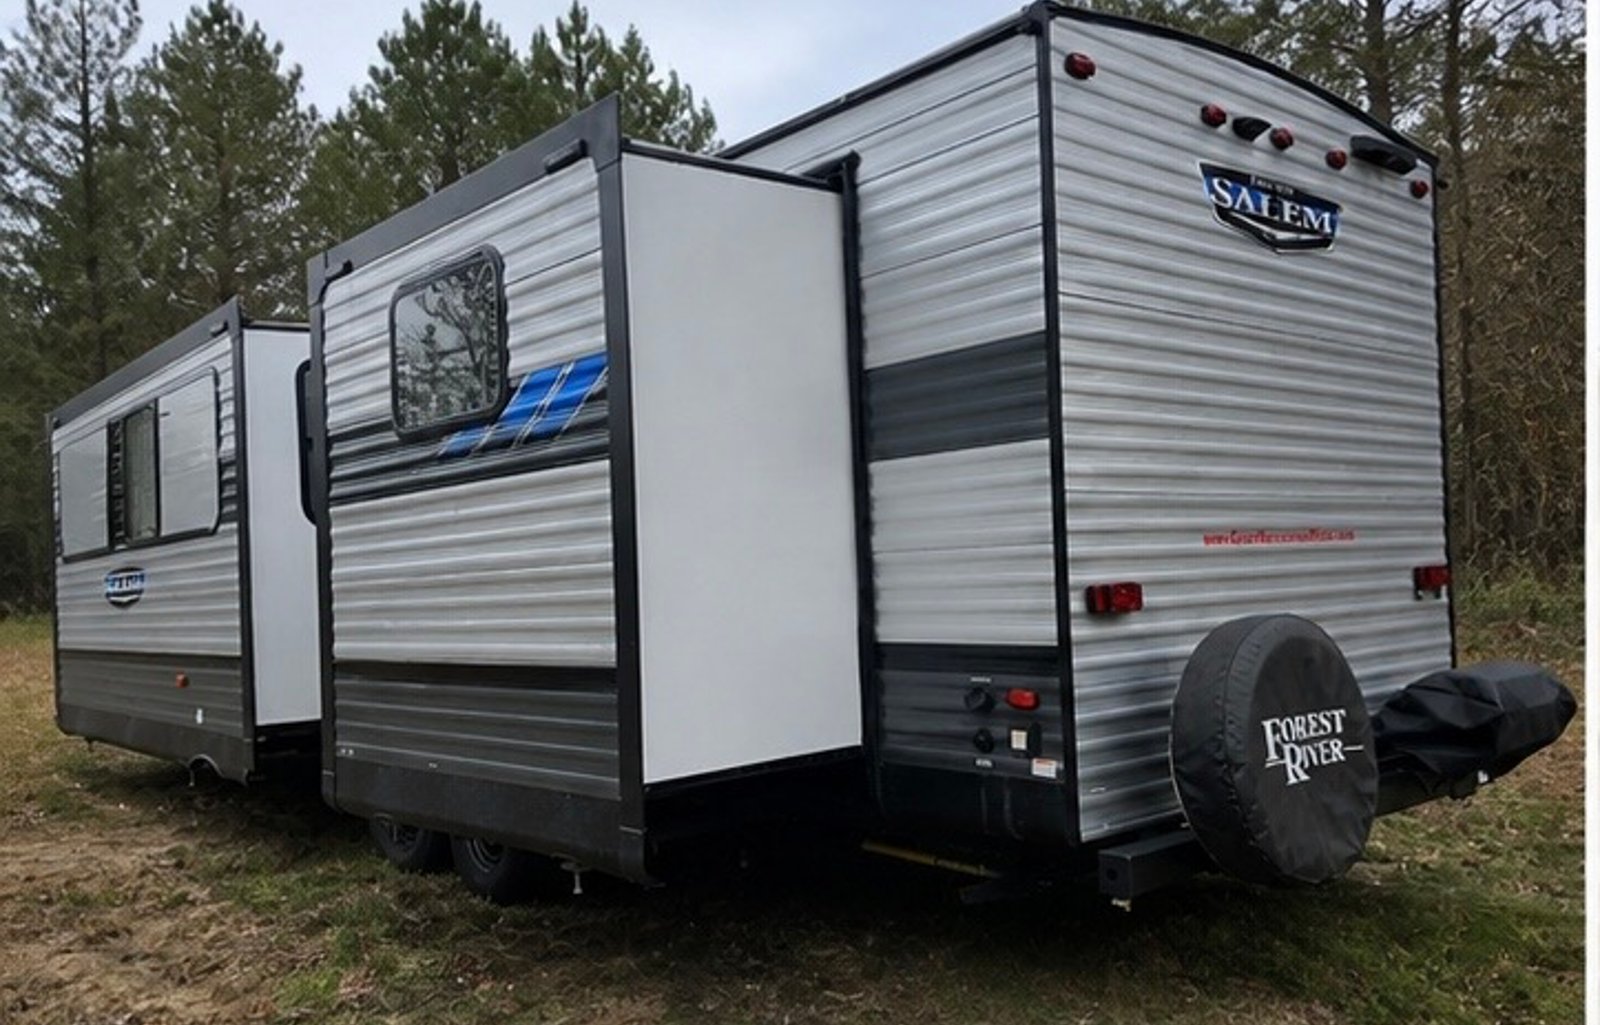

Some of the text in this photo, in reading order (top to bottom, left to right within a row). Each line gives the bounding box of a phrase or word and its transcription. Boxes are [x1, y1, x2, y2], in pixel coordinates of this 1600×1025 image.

[1211, 177, 1333, 233] SALEM
[1261, 709, 1346, 760] FOREST
[1281, 739, 1346, 786] RIVER
